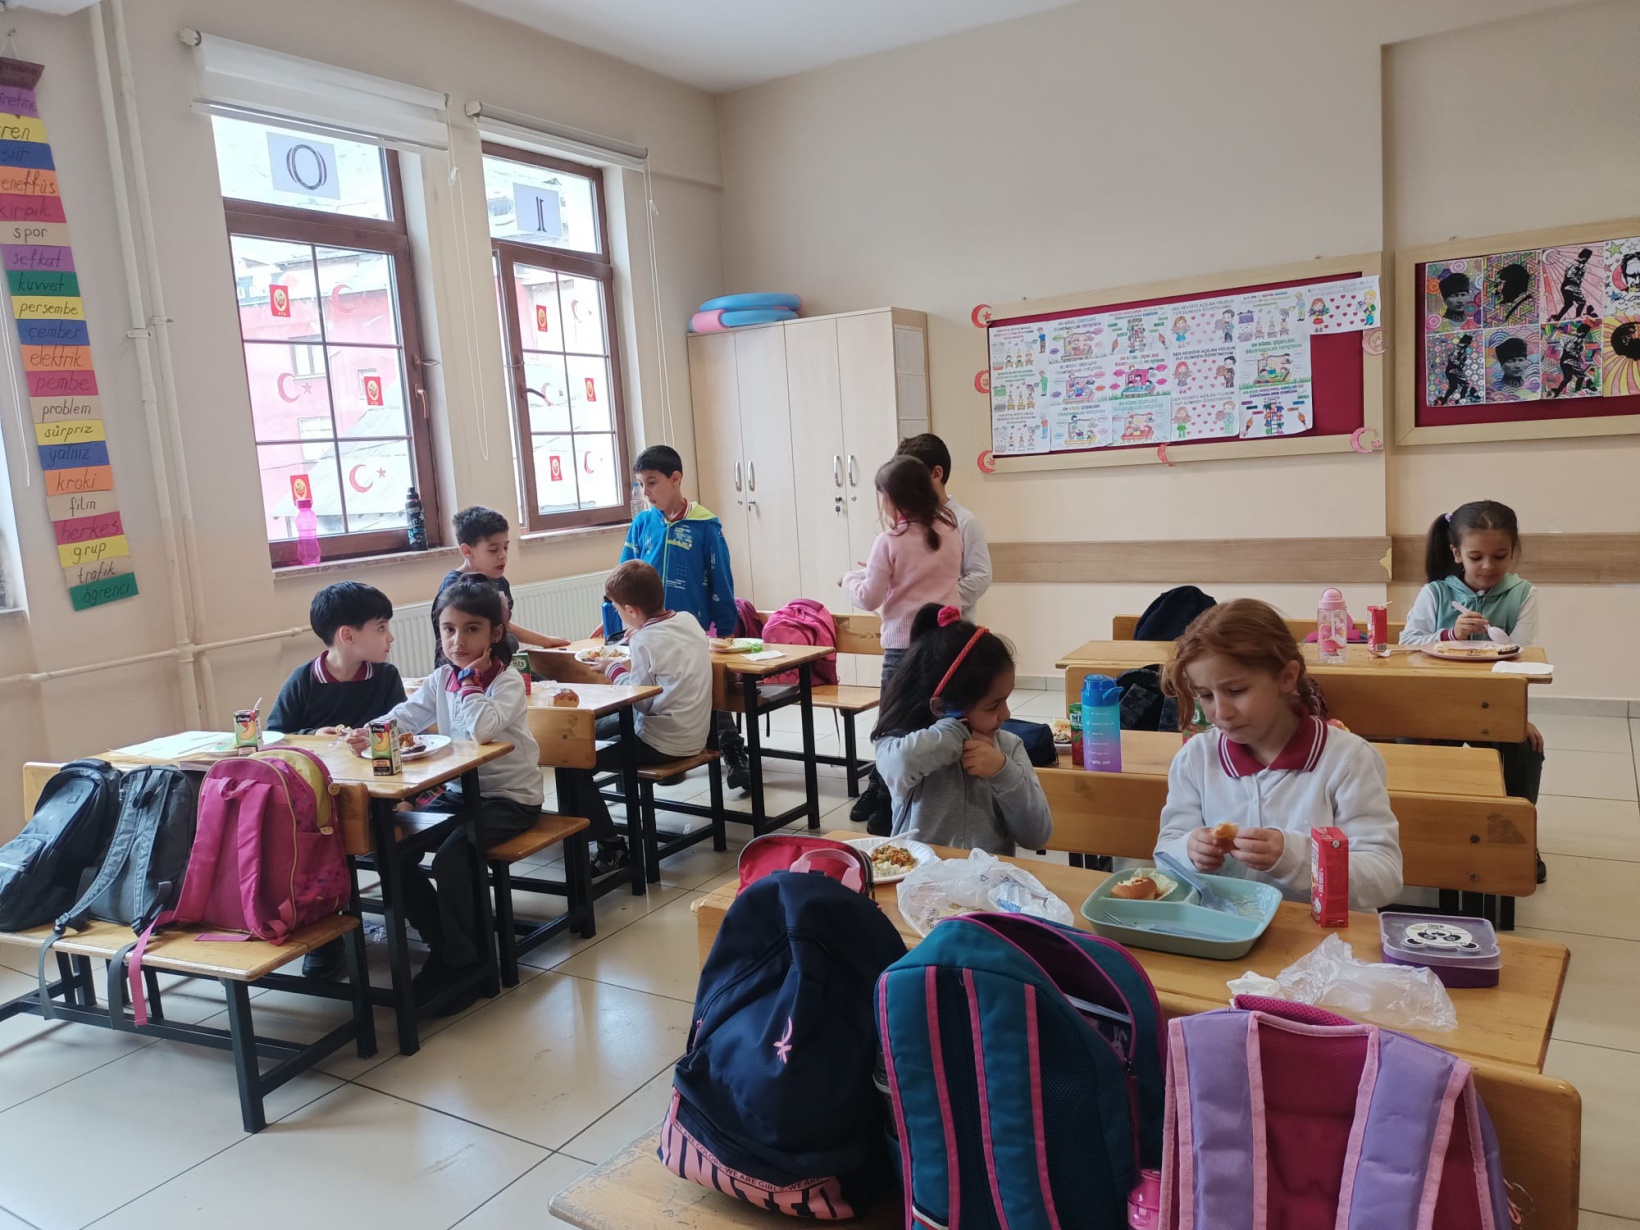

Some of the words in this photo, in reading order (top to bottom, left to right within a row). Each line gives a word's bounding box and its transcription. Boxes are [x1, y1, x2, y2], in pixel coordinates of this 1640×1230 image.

[0, 125, 30, 140] ren
[13, 227, 48, 244] spor
[18, 272, 65, 292] kuvvet
[30, 345, 83, 367] elektrik
[35, 371, 91, 396] pembe
[42, 398, 92, 423] problem
[56, 468, 97, 492] kroki
[69, 496, 96, 517] film
[61, 517, 119, 541] herkes
[73, 542, 106, 565] grup
[77, 561, 116, 584] trafik
[739, 1174, 757, 1184] ARE
